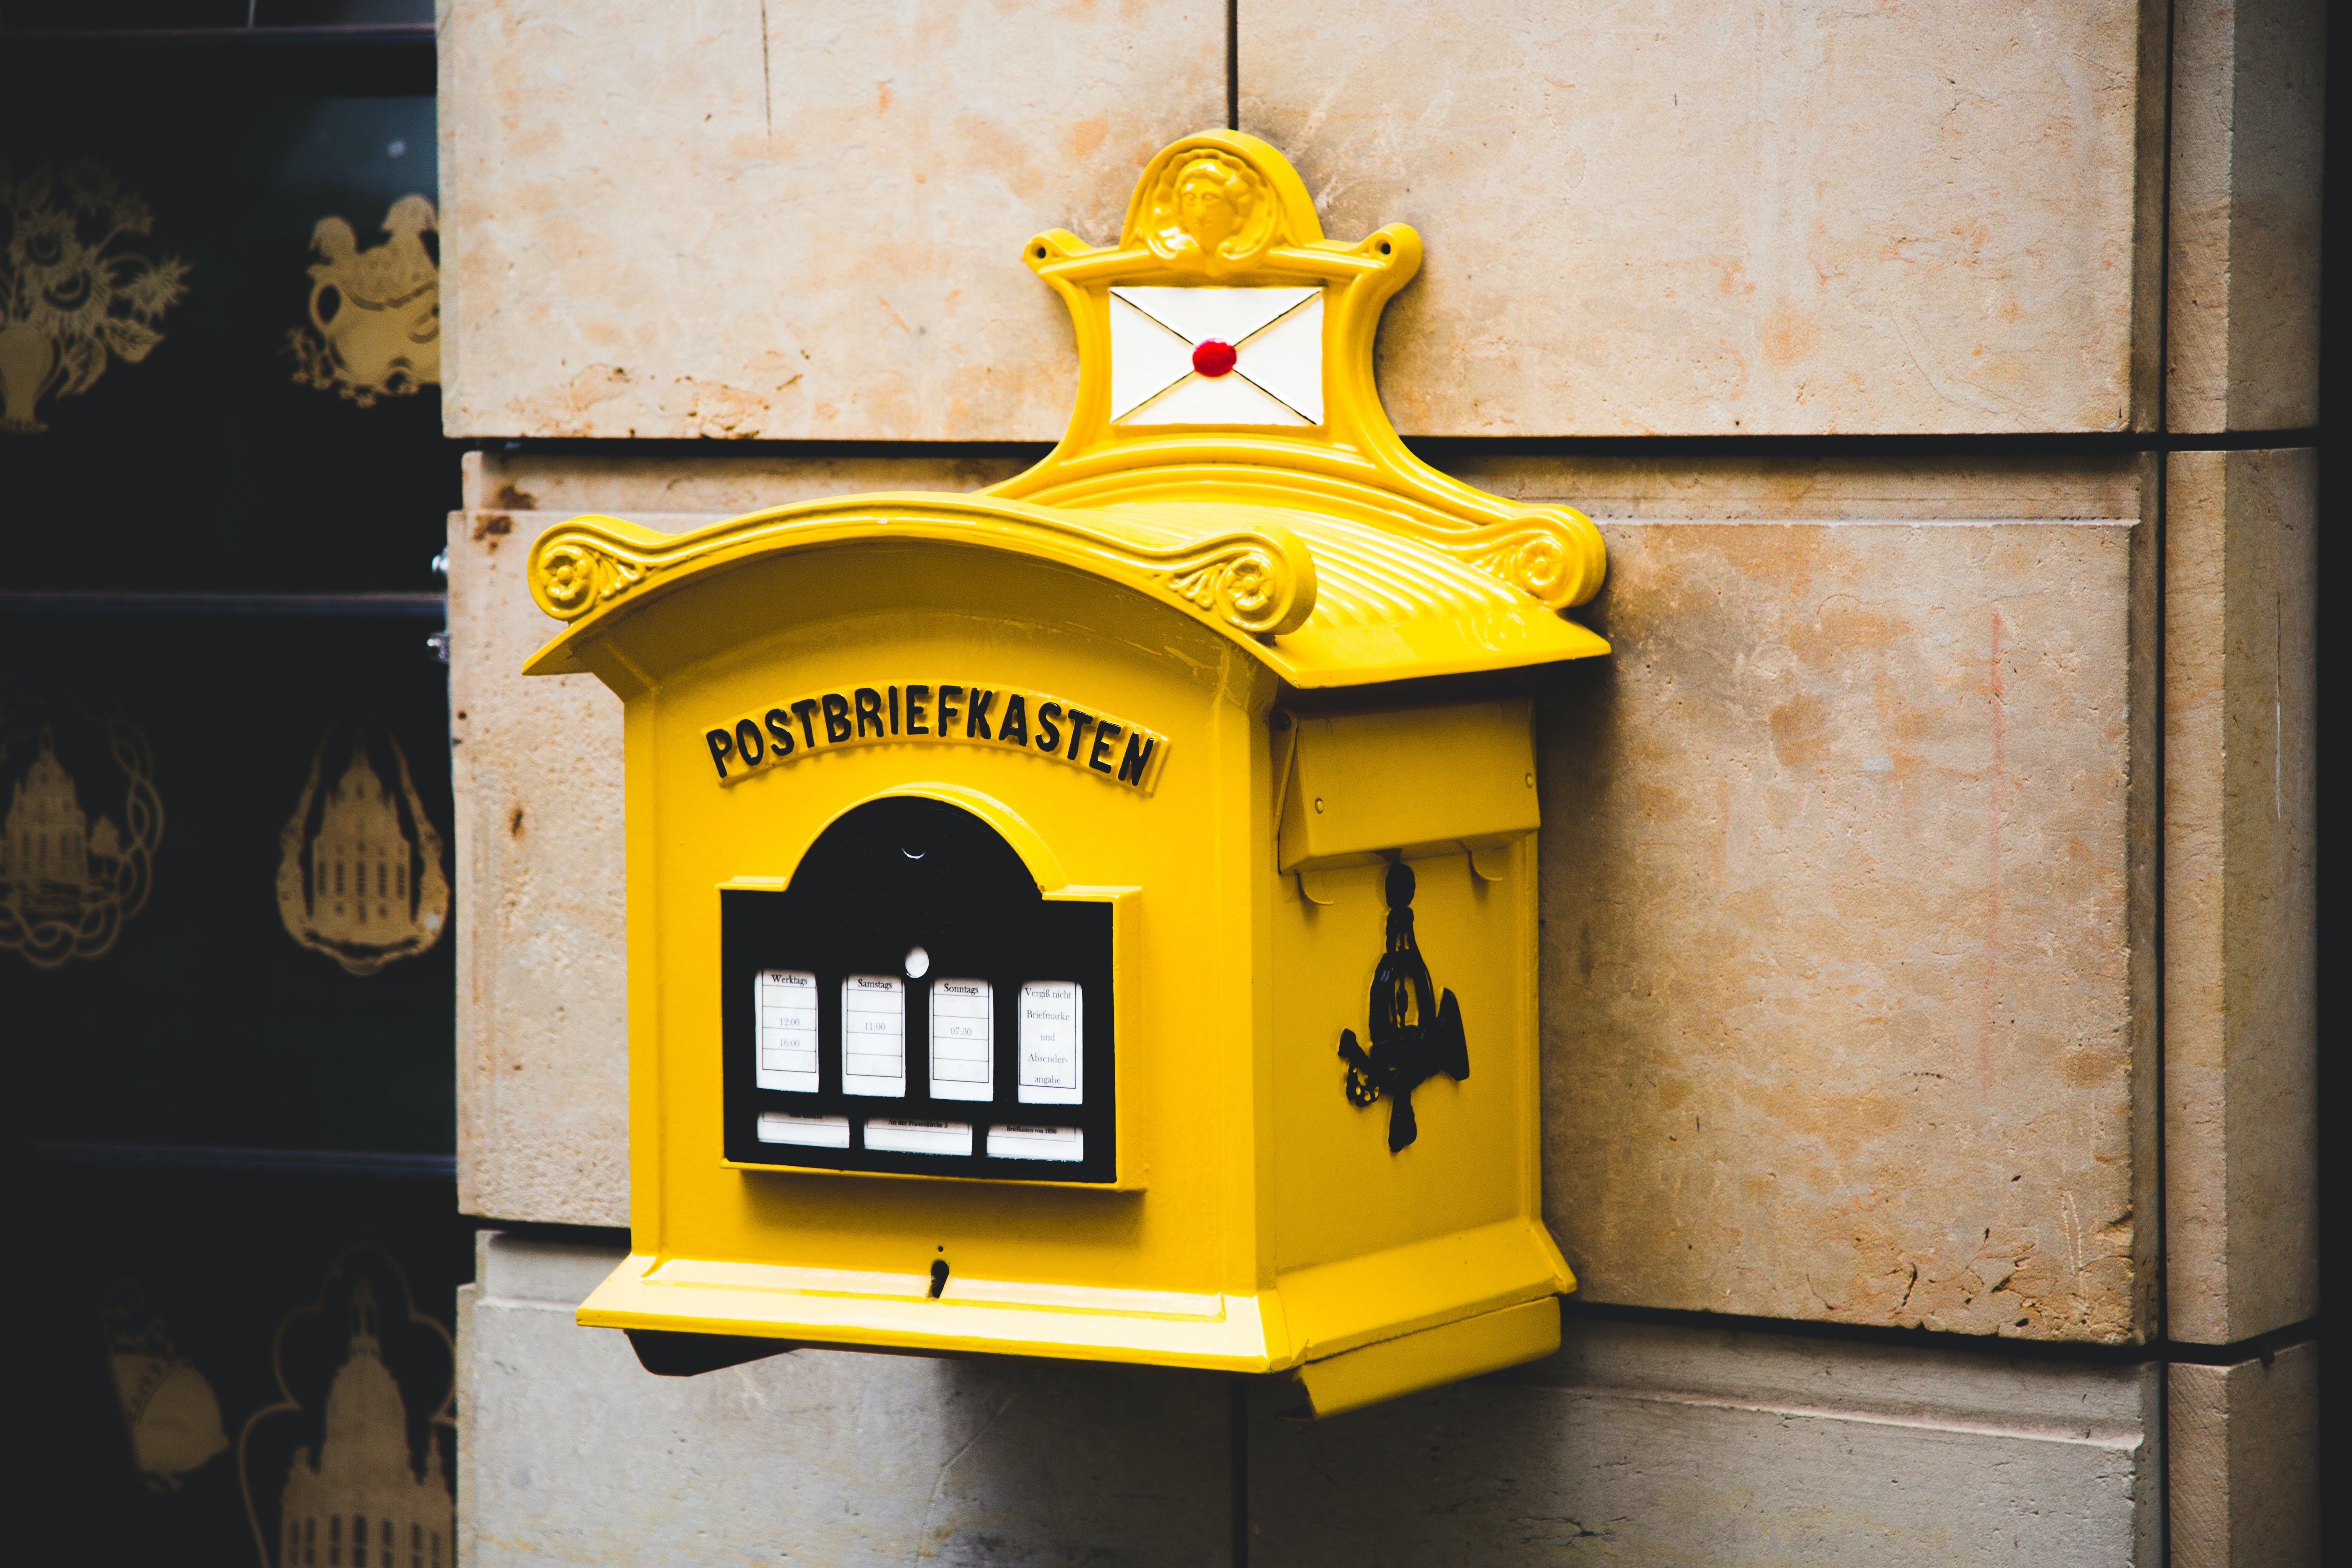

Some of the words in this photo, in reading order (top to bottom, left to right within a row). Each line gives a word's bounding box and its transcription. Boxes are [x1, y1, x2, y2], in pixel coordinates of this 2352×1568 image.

[706, 684, 1154, 787] POSTBRIEFKASTEN
[771, 974, 808, 987] Werktags
[857, 979, 893, 990] Samstags
[944, 983, 979, 995] Sonntags
[1025, 988, 1050, 999] Vergiß
[1052, 990, 1072, 1000] nicht
[1026, 1010, 1070, 1021] Briefmarke
[780, 1018, 800, 1027] 12:00
[864, 1022, 886, 1031] 11:00
[950, 1027, 973, 1036] 07:30
[1040, 1033, 1056, 1042] und
[780, 1038, 800, 1048] 16:00
[1028, 1054, 1068, 1064] Absender-
[1034, 1075, 1061, 1085] angabe
